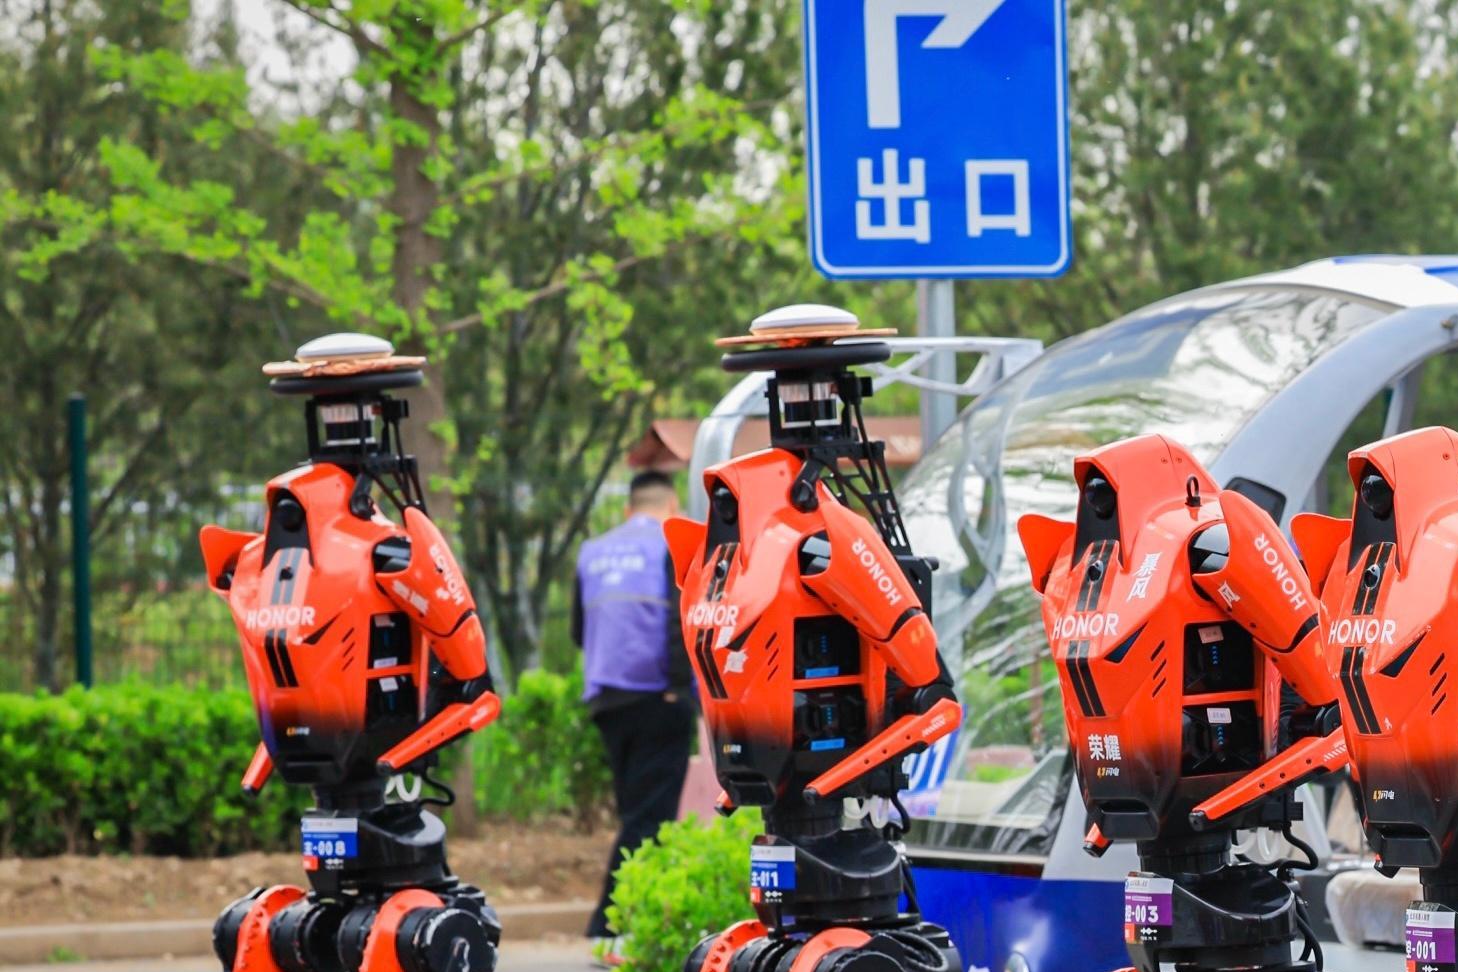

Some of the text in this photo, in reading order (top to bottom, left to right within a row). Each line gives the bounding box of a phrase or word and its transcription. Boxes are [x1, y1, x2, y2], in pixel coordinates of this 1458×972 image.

[855, 147, 1031, 244] 出口
[429, 543, 465, 605] HONOR
[852, 537, 902, 606] HONOR
[1254, 532, 1306, 611] HONOR
[246, 606, 316, 629] HONOR
[686, 602, 740, 626] HONOR
[1052, 612, 1120, 640] HONOR
[1327, 618, 1397, 645] HONOR
[1087, 734, 1122, 761] 荣耀
